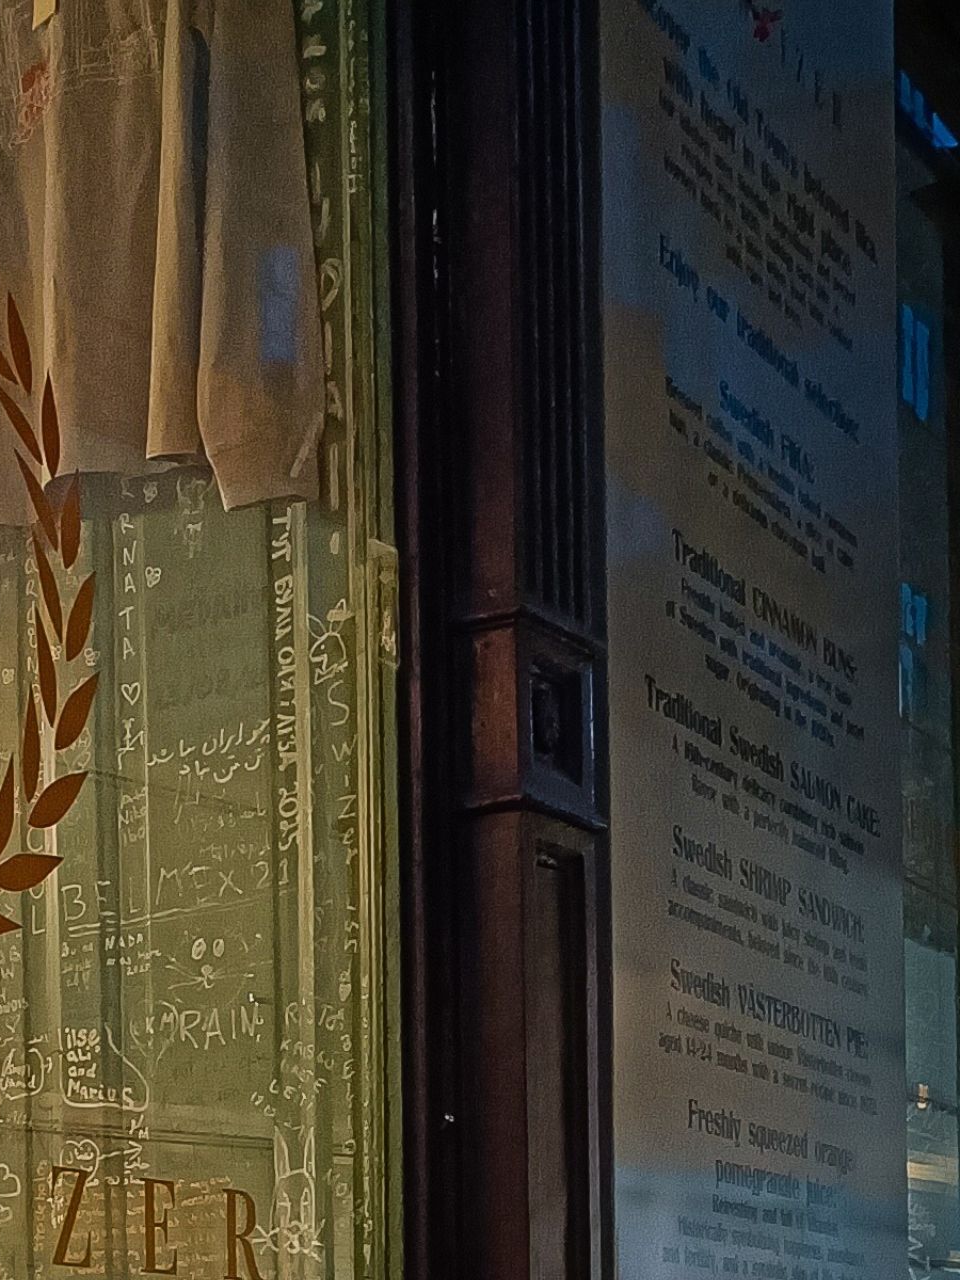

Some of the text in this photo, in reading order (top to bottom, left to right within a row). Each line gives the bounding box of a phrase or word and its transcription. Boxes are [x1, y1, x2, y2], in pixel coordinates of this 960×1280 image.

[672, 528, 746, 607] Traditional
[644, 673, 723, 747] Traditional
[729, 725, 785, 783] Swedish
[790, 760, 842, 813] SALMON
[672, 823, 733, 882] Swedish
[740, 857, 792, 907] SHRIMP
[670, 957, 731, 1011] Swedish
[687, 1098, 742, 1148] Freshly
[748, 1121, 809, 1160] squeezed
[715, 1159, 801, 1198] pomegranate
